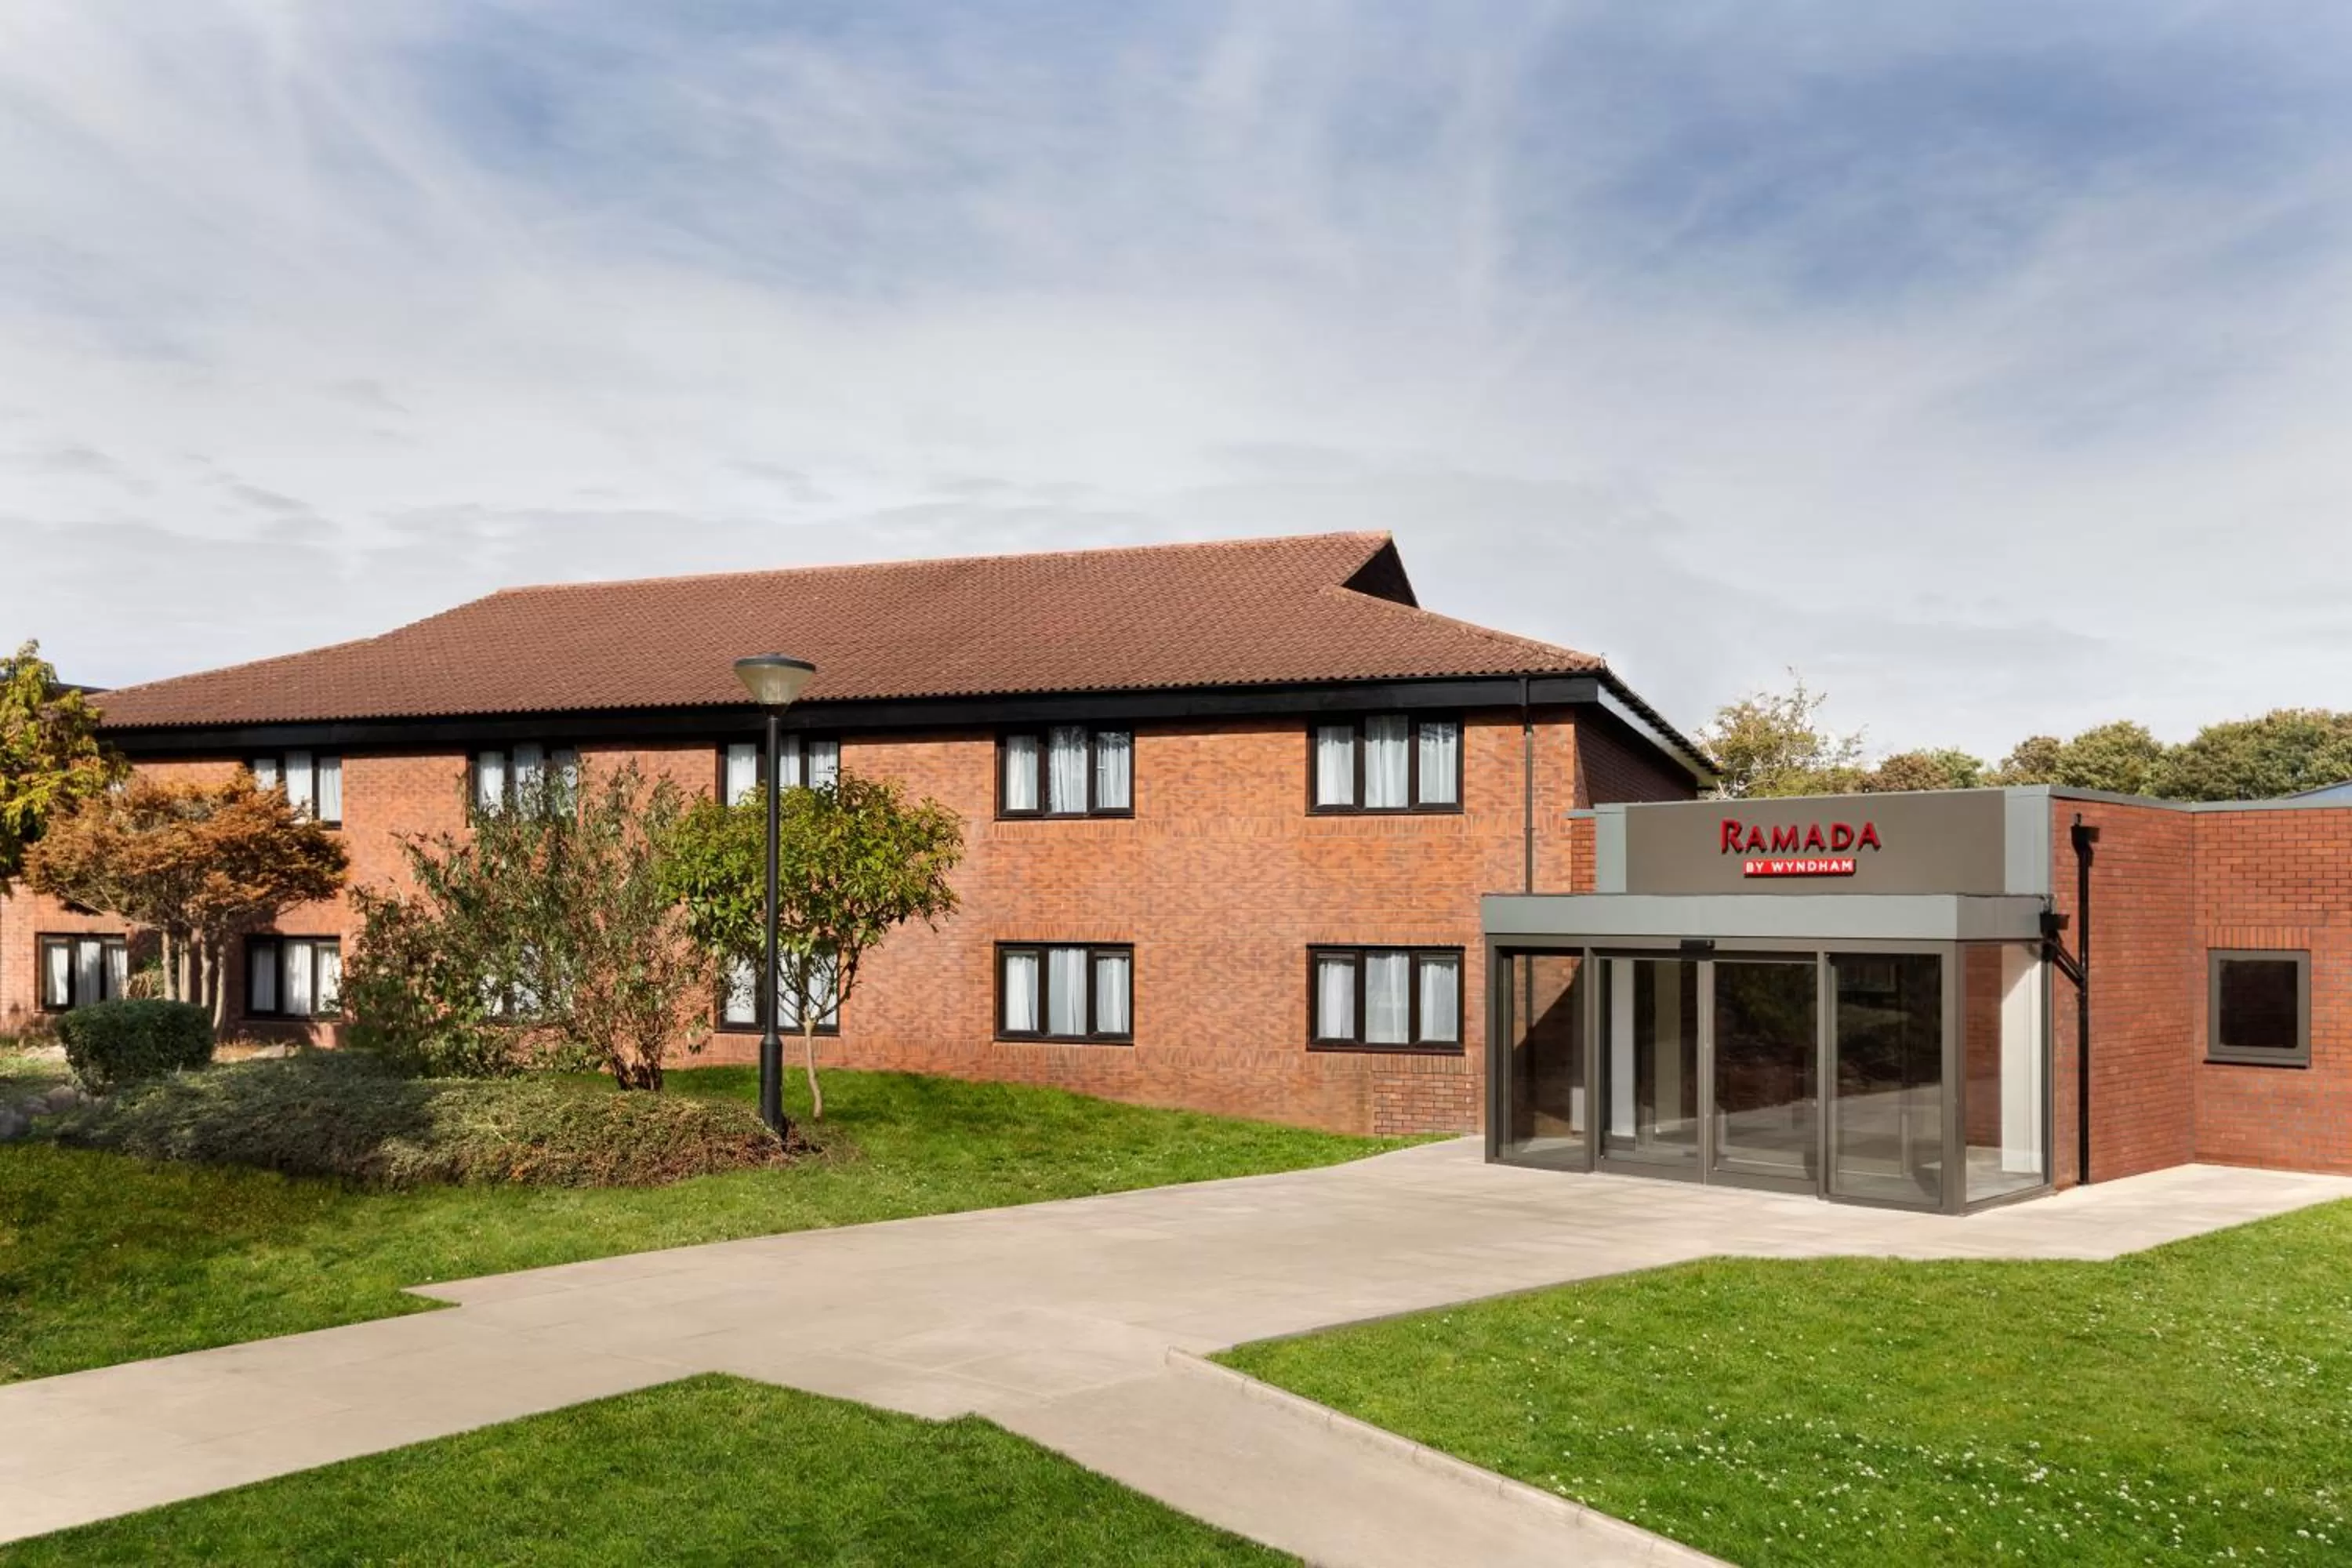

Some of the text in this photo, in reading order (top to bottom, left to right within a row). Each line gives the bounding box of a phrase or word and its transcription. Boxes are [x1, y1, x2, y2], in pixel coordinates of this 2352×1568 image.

[1721, 818, 1881, 854] RAMADA
[1746, 860, 1853, 873] BY WYNDHAM
